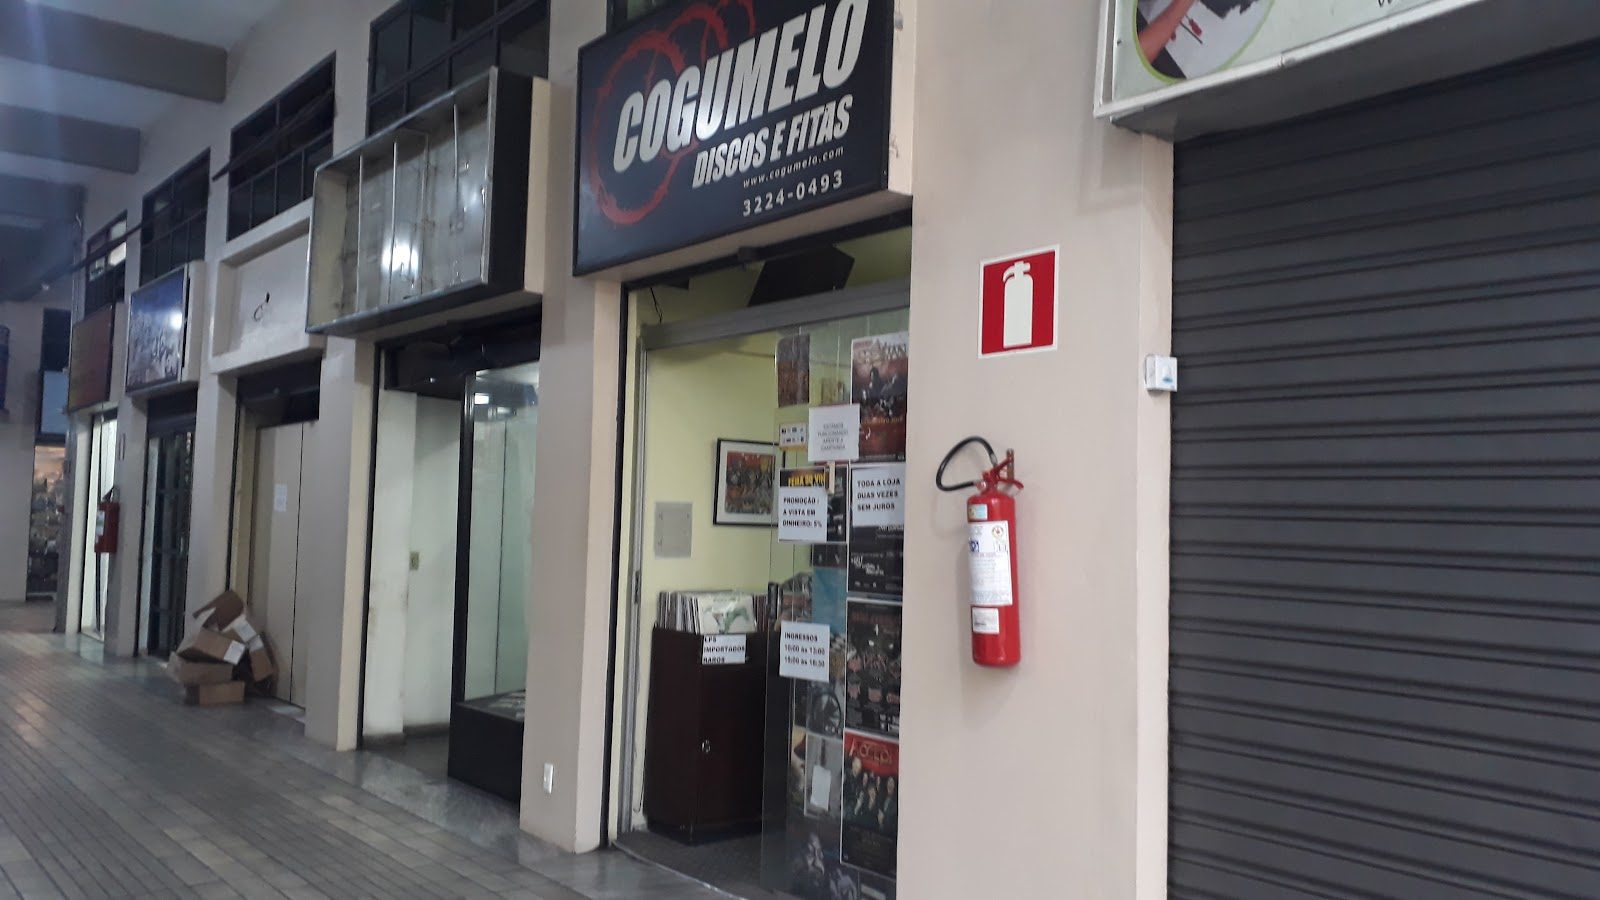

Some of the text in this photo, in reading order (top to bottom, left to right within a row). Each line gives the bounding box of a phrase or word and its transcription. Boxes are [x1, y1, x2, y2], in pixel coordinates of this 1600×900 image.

[613, 0, 869, 173] COGUMELO
[692, 94, 853, 189] DISCOS E FITAS
[743, 146, 844, 189] www.cogumelo.com
[743, 170, 843, 217] 3224-0493
[882, 478, 901, 486] LOJA
[876, 490, 898, 498] VEZES
[873, 502, 895, 510] JUROS
[788, 508, 806, 516] VISTA
[784, 631, 818, 642] INGRESSOS
